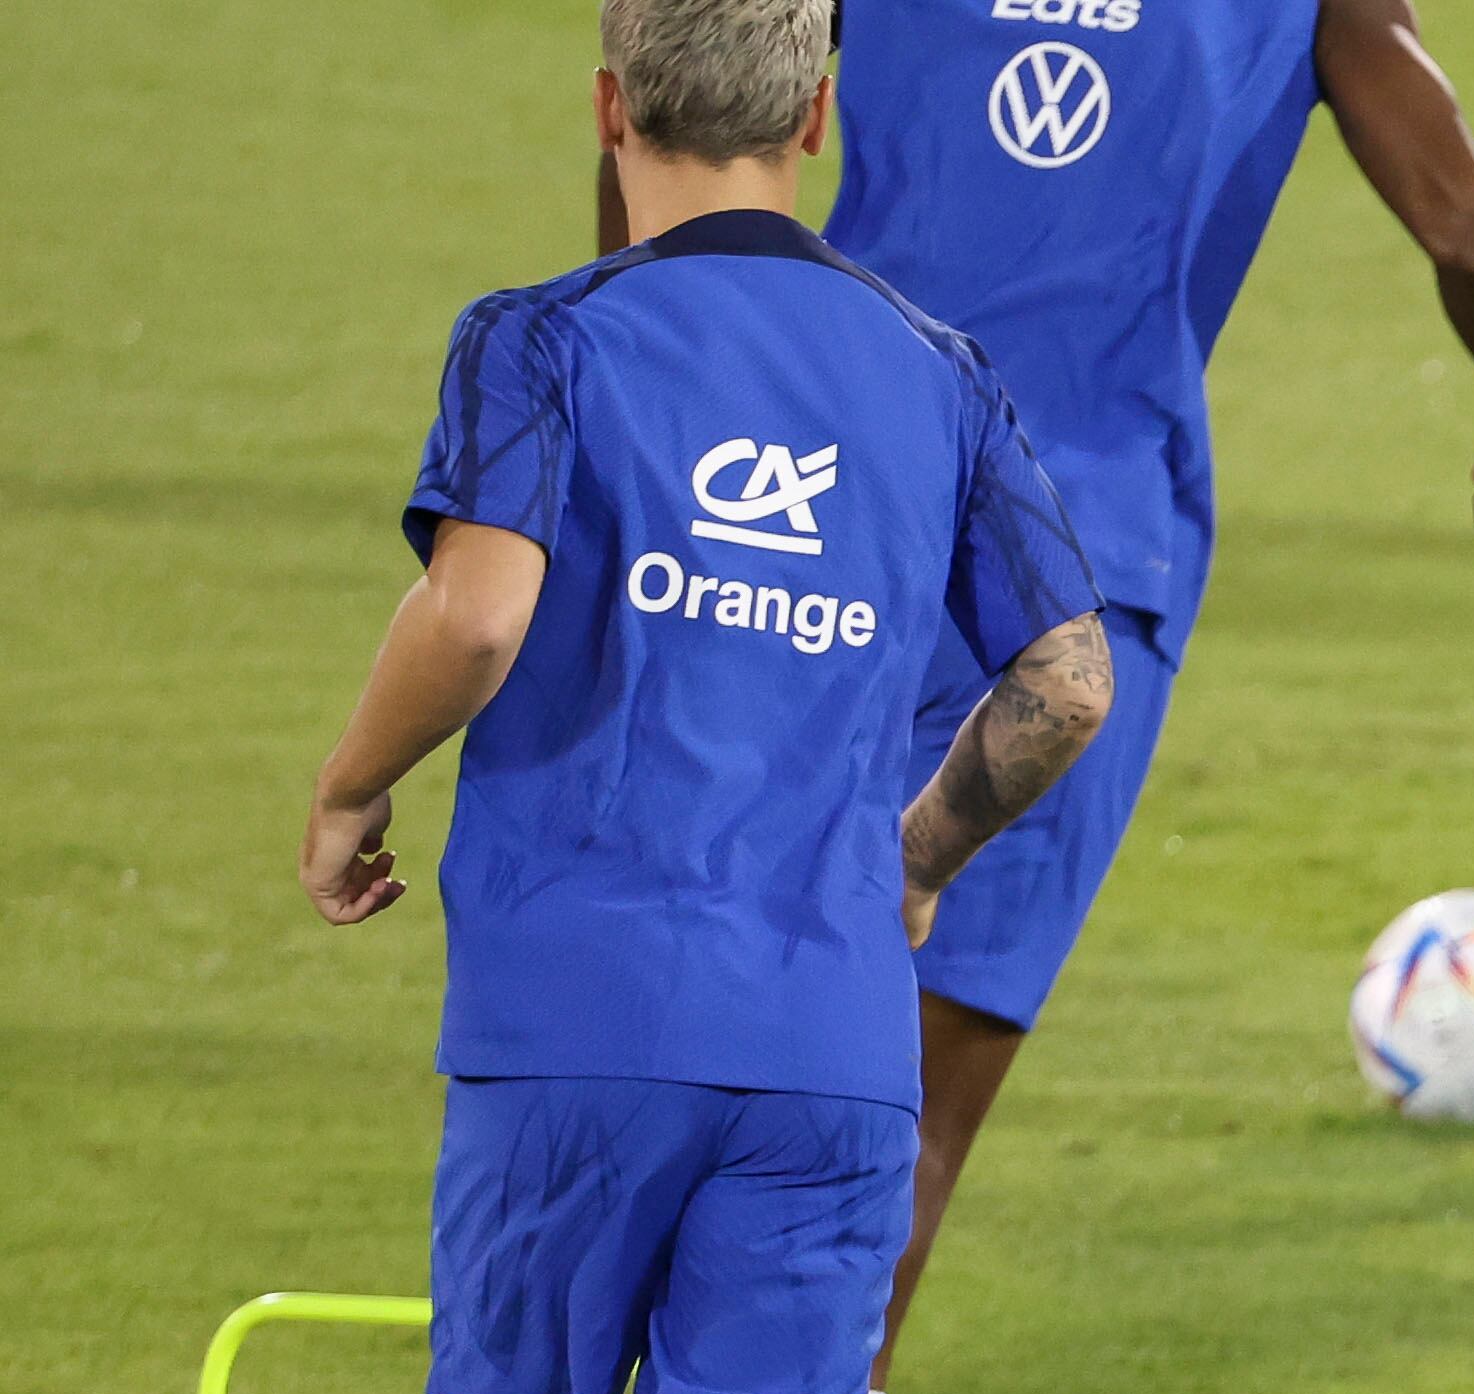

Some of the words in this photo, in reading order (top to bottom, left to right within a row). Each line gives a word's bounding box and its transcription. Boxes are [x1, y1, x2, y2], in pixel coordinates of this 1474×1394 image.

[988, 41, 1110, 169] VW
[691, 438, 838, 533] CA
[627, 552, 876, 654] Orange
